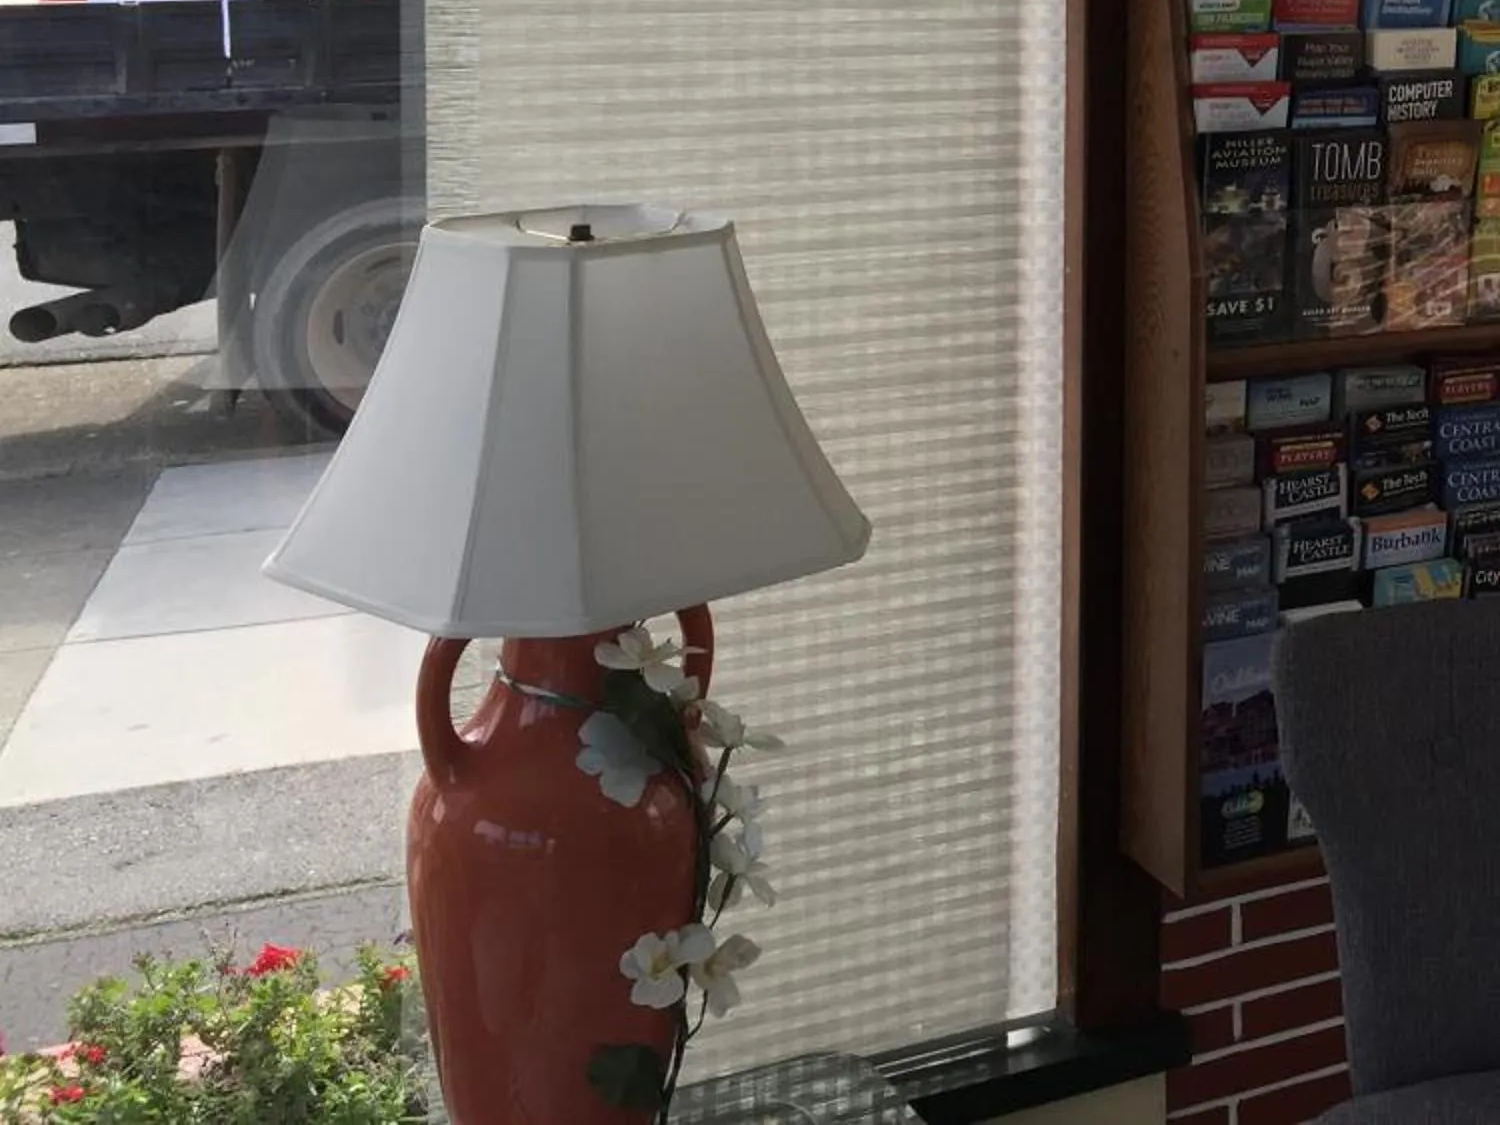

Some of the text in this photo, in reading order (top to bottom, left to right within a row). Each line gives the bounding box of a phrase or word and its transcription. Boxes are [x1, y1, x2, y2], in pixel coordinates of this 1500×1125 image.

[1387, 79, 1454, 103] COMPUTER
[1386, 99, 1439, 122] HISTORY
[1310, 140, 1384, 182] TOMB
[1206, 298, 1250, 317] SAVE
[1449, 437, 1497, 454] COAST
[1279, 473, 1331, 495] HEARST
[1292, 535, 1343, 554] HEARST
[1372, 527, 1442, 552] Burbank
